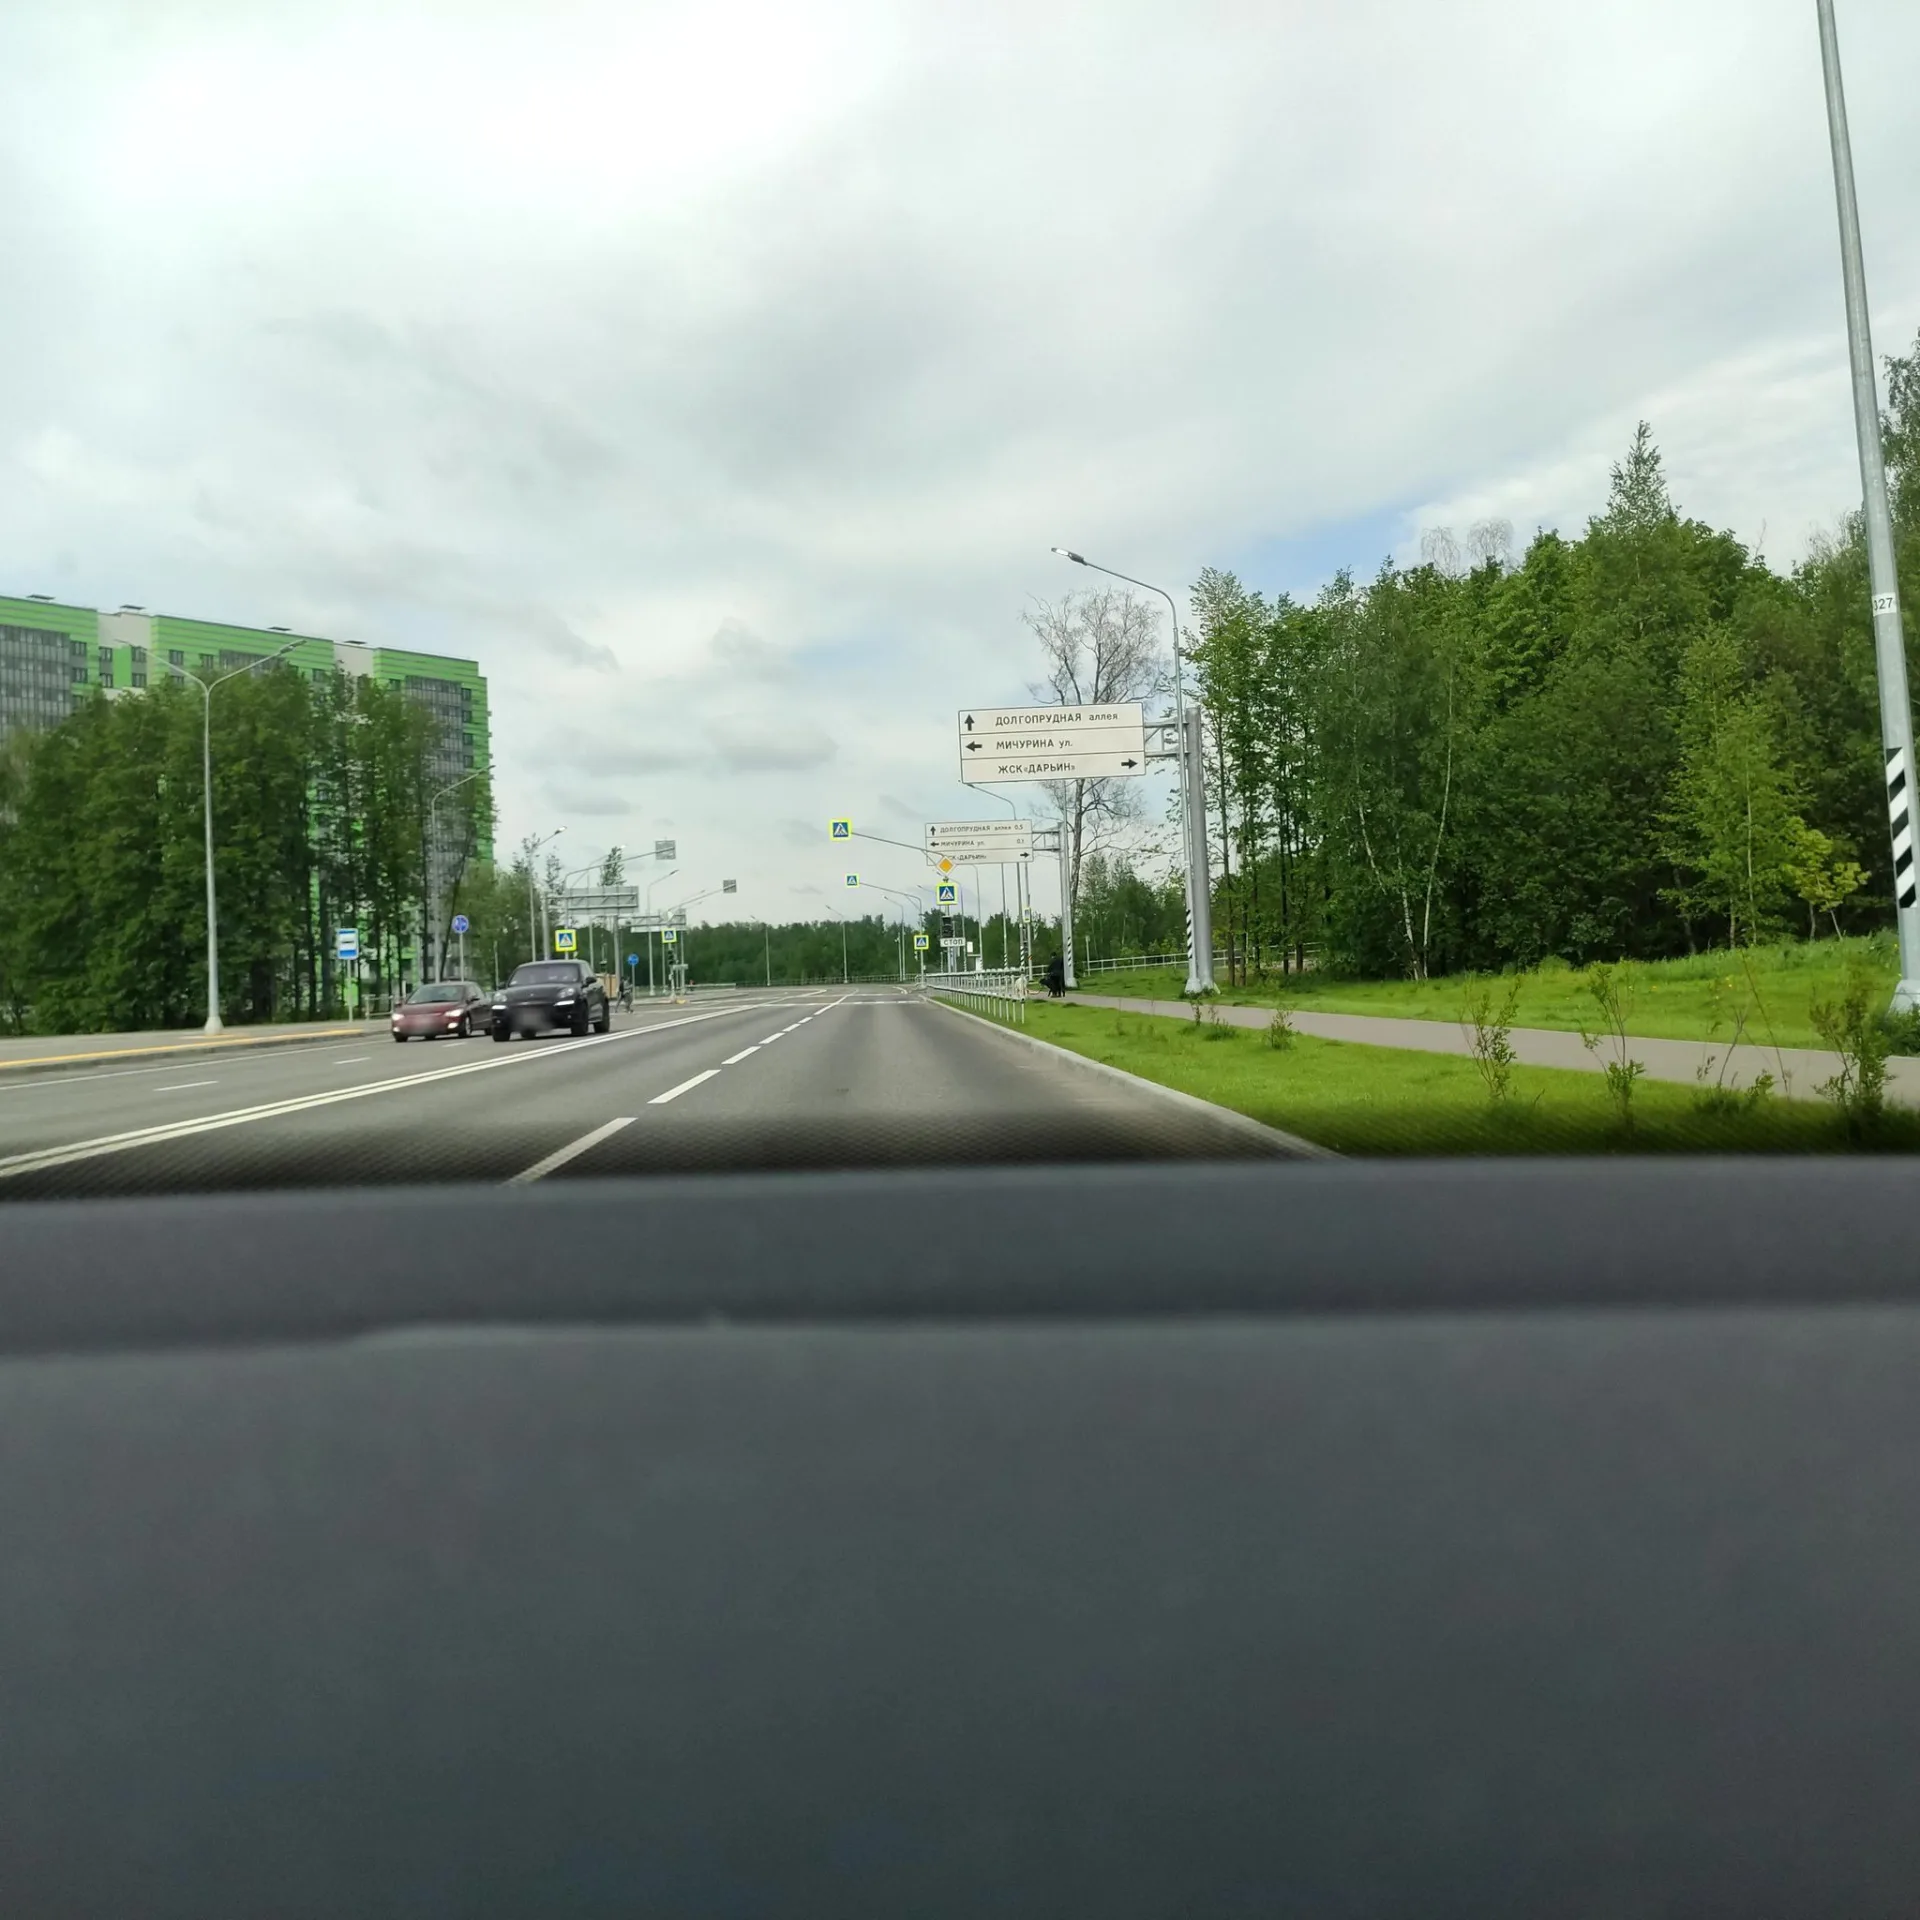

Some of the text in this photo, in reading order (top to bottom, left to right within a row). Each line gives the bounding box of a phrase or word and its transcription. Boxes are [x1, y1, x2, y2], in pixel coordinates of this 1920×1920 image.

[995, 713, 1119, 726] ДОЛГОПРУДНАЯ аллея
[996, 739, 1073, 750] МИЧУРИНА ул.
[940, 825, 991, 833] ДОЛГОПРУДНАЯ
[943, 938, 963, 946] СТОП
